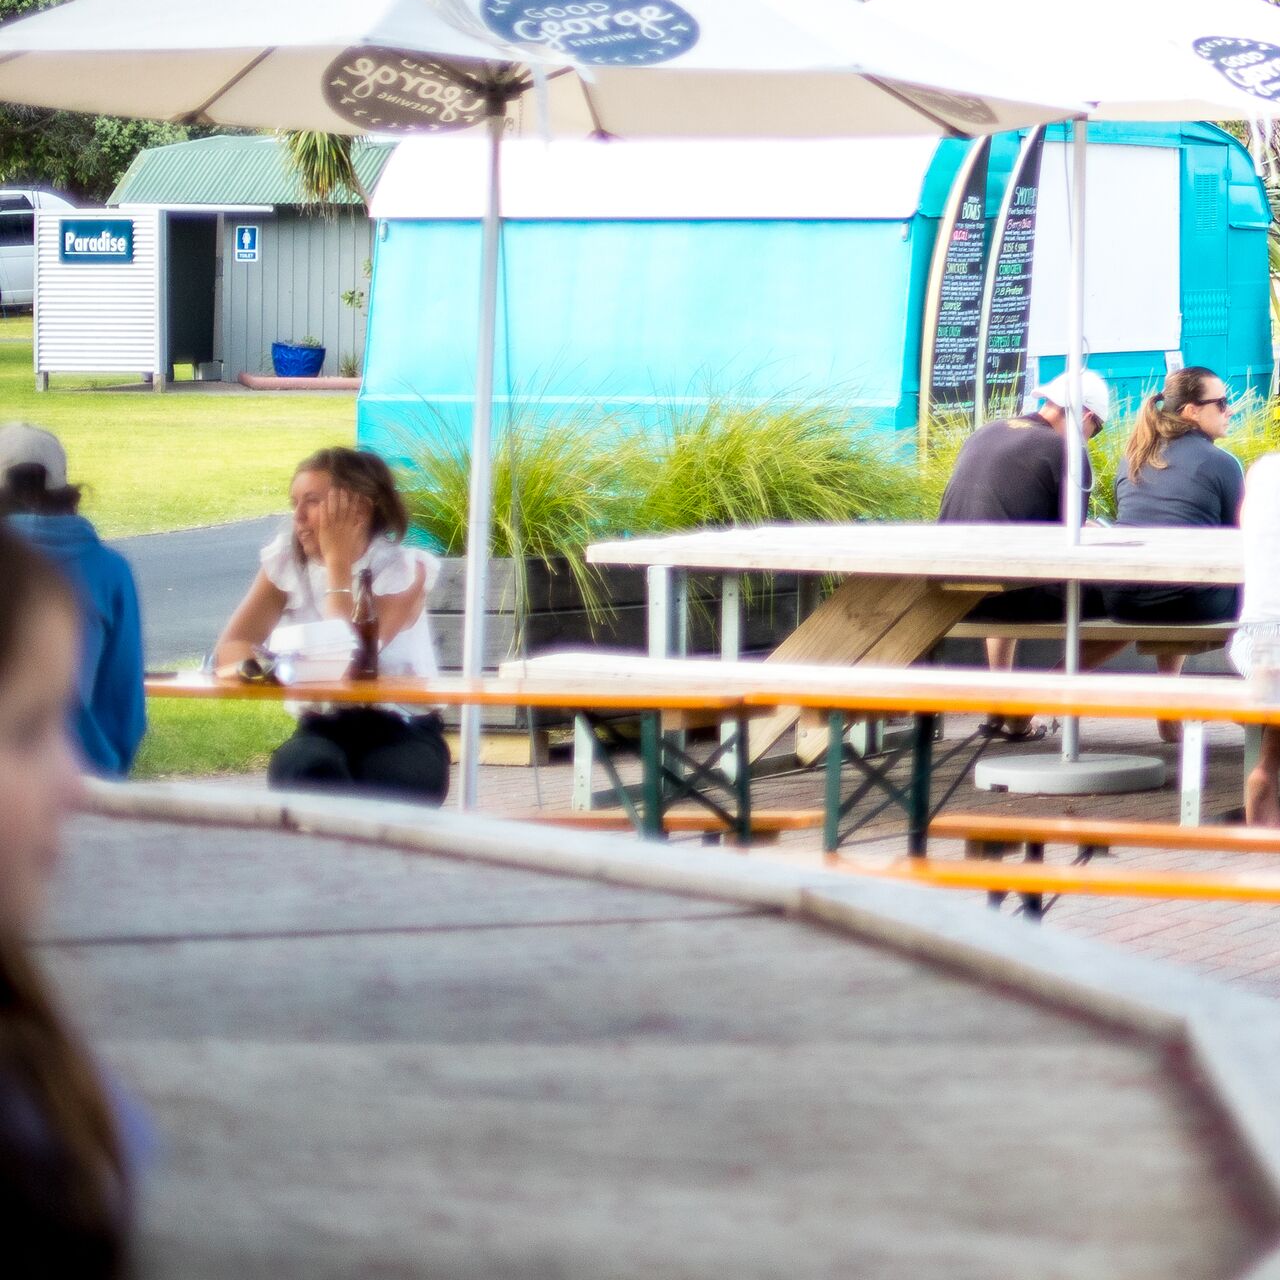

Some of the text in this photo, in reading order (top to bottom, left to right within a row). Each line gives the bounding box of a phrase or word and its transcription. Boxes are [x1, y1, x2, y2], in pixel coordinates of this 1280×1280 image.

[522, 1, 609, 21] GOOD
[512, 5, 674, 51] George
[569, 31, 636, 48] BREWING
[1220, 51, 1265, 68] GOOD
[65, 231, 126, 252] Paradise
